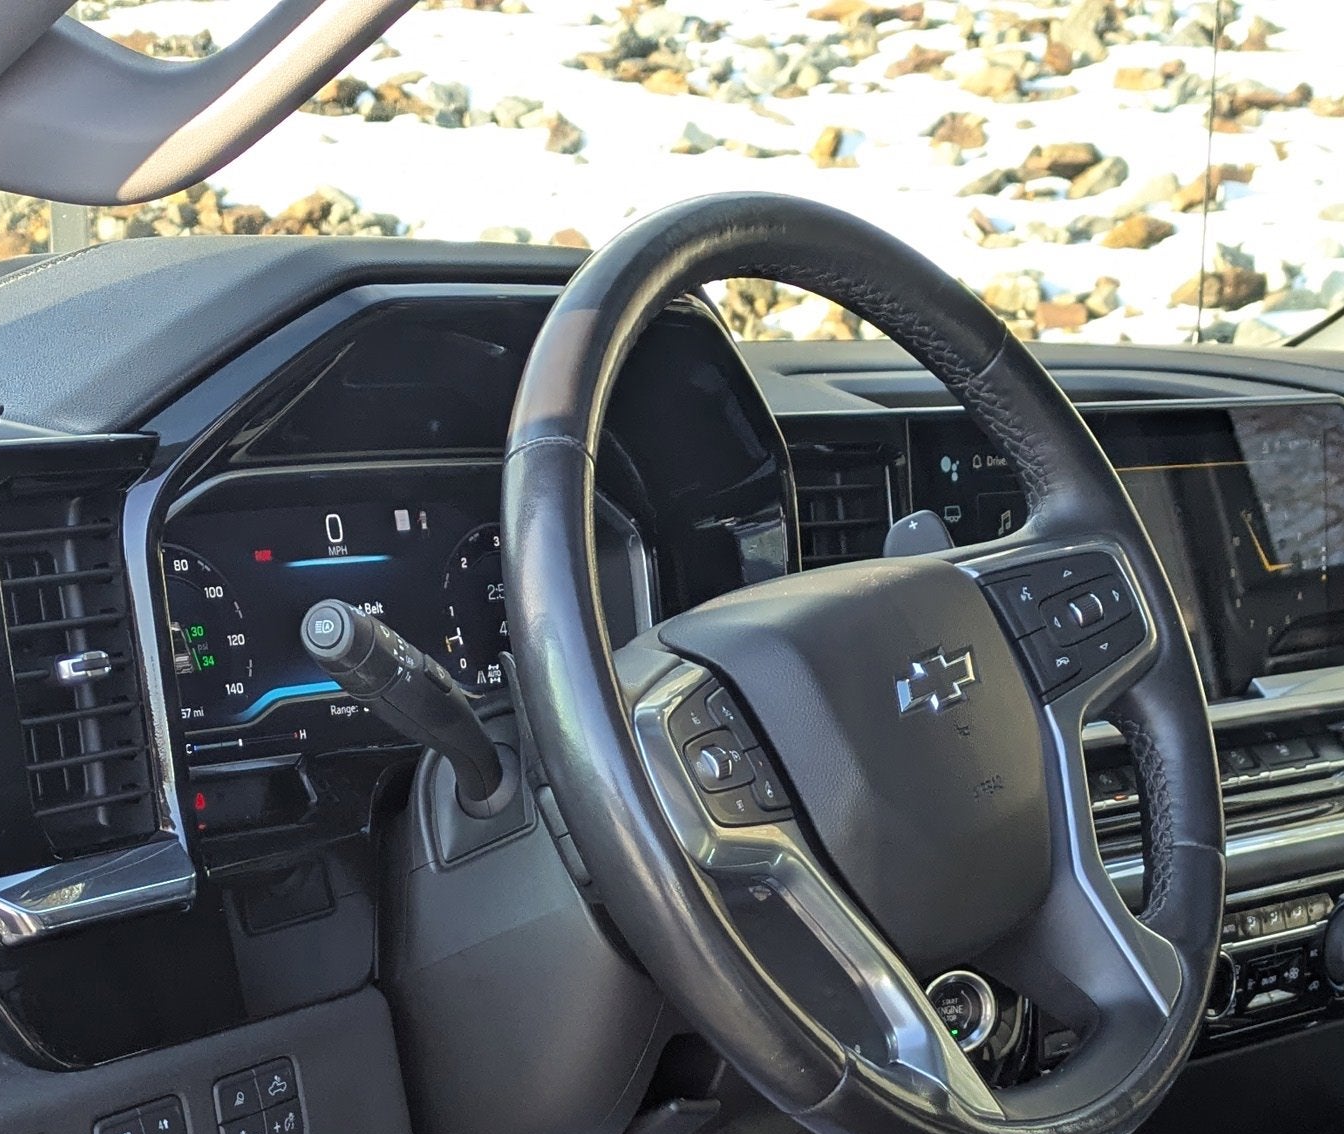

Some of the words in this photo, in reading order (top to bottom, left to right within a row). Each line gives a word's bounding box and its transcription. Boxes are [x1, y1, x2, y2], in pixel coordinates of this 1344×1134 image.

[325, 513, 344, 543] 0
[493, 536, 501, 547] 3
[328, 545, 348, 556] MPH
[173, 559, 189, 572] 80
[460, 557, 468, 568] 2
[204, 586, 224, 599] 100
[364, 601, 384, 615] Belt
[449, 605, 455, 617] 1
[190, 626, 204, 638] 30
[227, 633, 246, 647] 120
[202, 656, 215, 667] 34
[459, 657, 467, 669] 0
[225, 682, 244, 695] 140
[193, 706, 205, 718] mi
[299, 730, 307, 740] H
[185, 744, 193, 755] C
